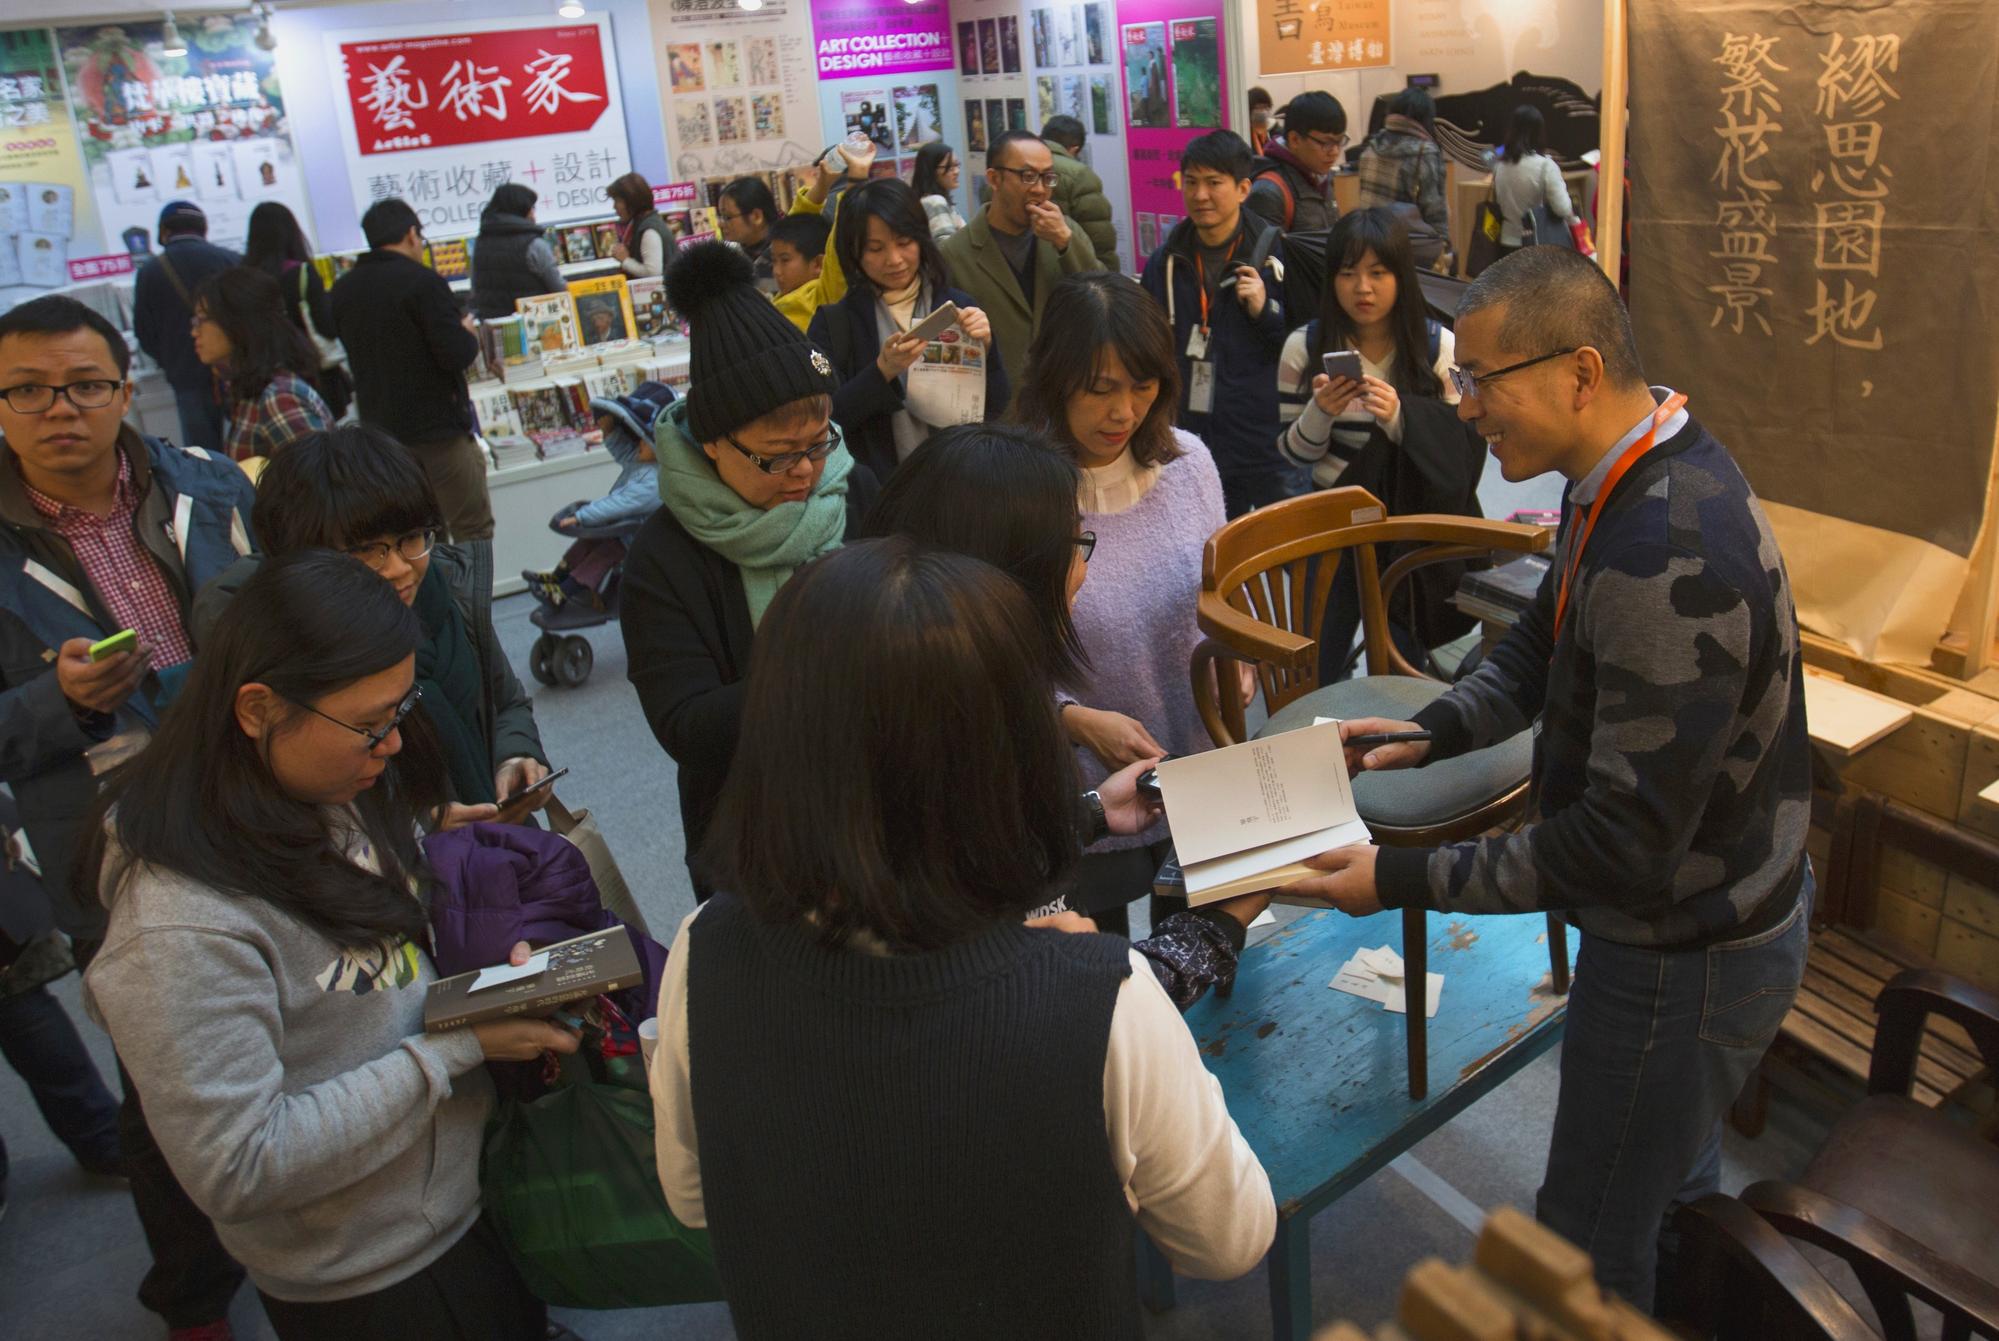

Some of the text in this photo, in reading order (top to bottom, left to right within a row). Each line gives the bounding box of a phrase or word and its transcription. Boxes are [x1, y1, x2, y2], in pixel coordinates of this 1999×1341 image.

[819, 38, 849, 54] ART
[849, 32, 940, 53] COLLECTION
[820, 52, 883, 72] DESIGN
[358, 49, 602, 131] 藝術家
[552, 148, 616, 183] 設計
[556, 186, 609, 208] DESIG
[1707, 32, 1790, 336] 繁花盛景
